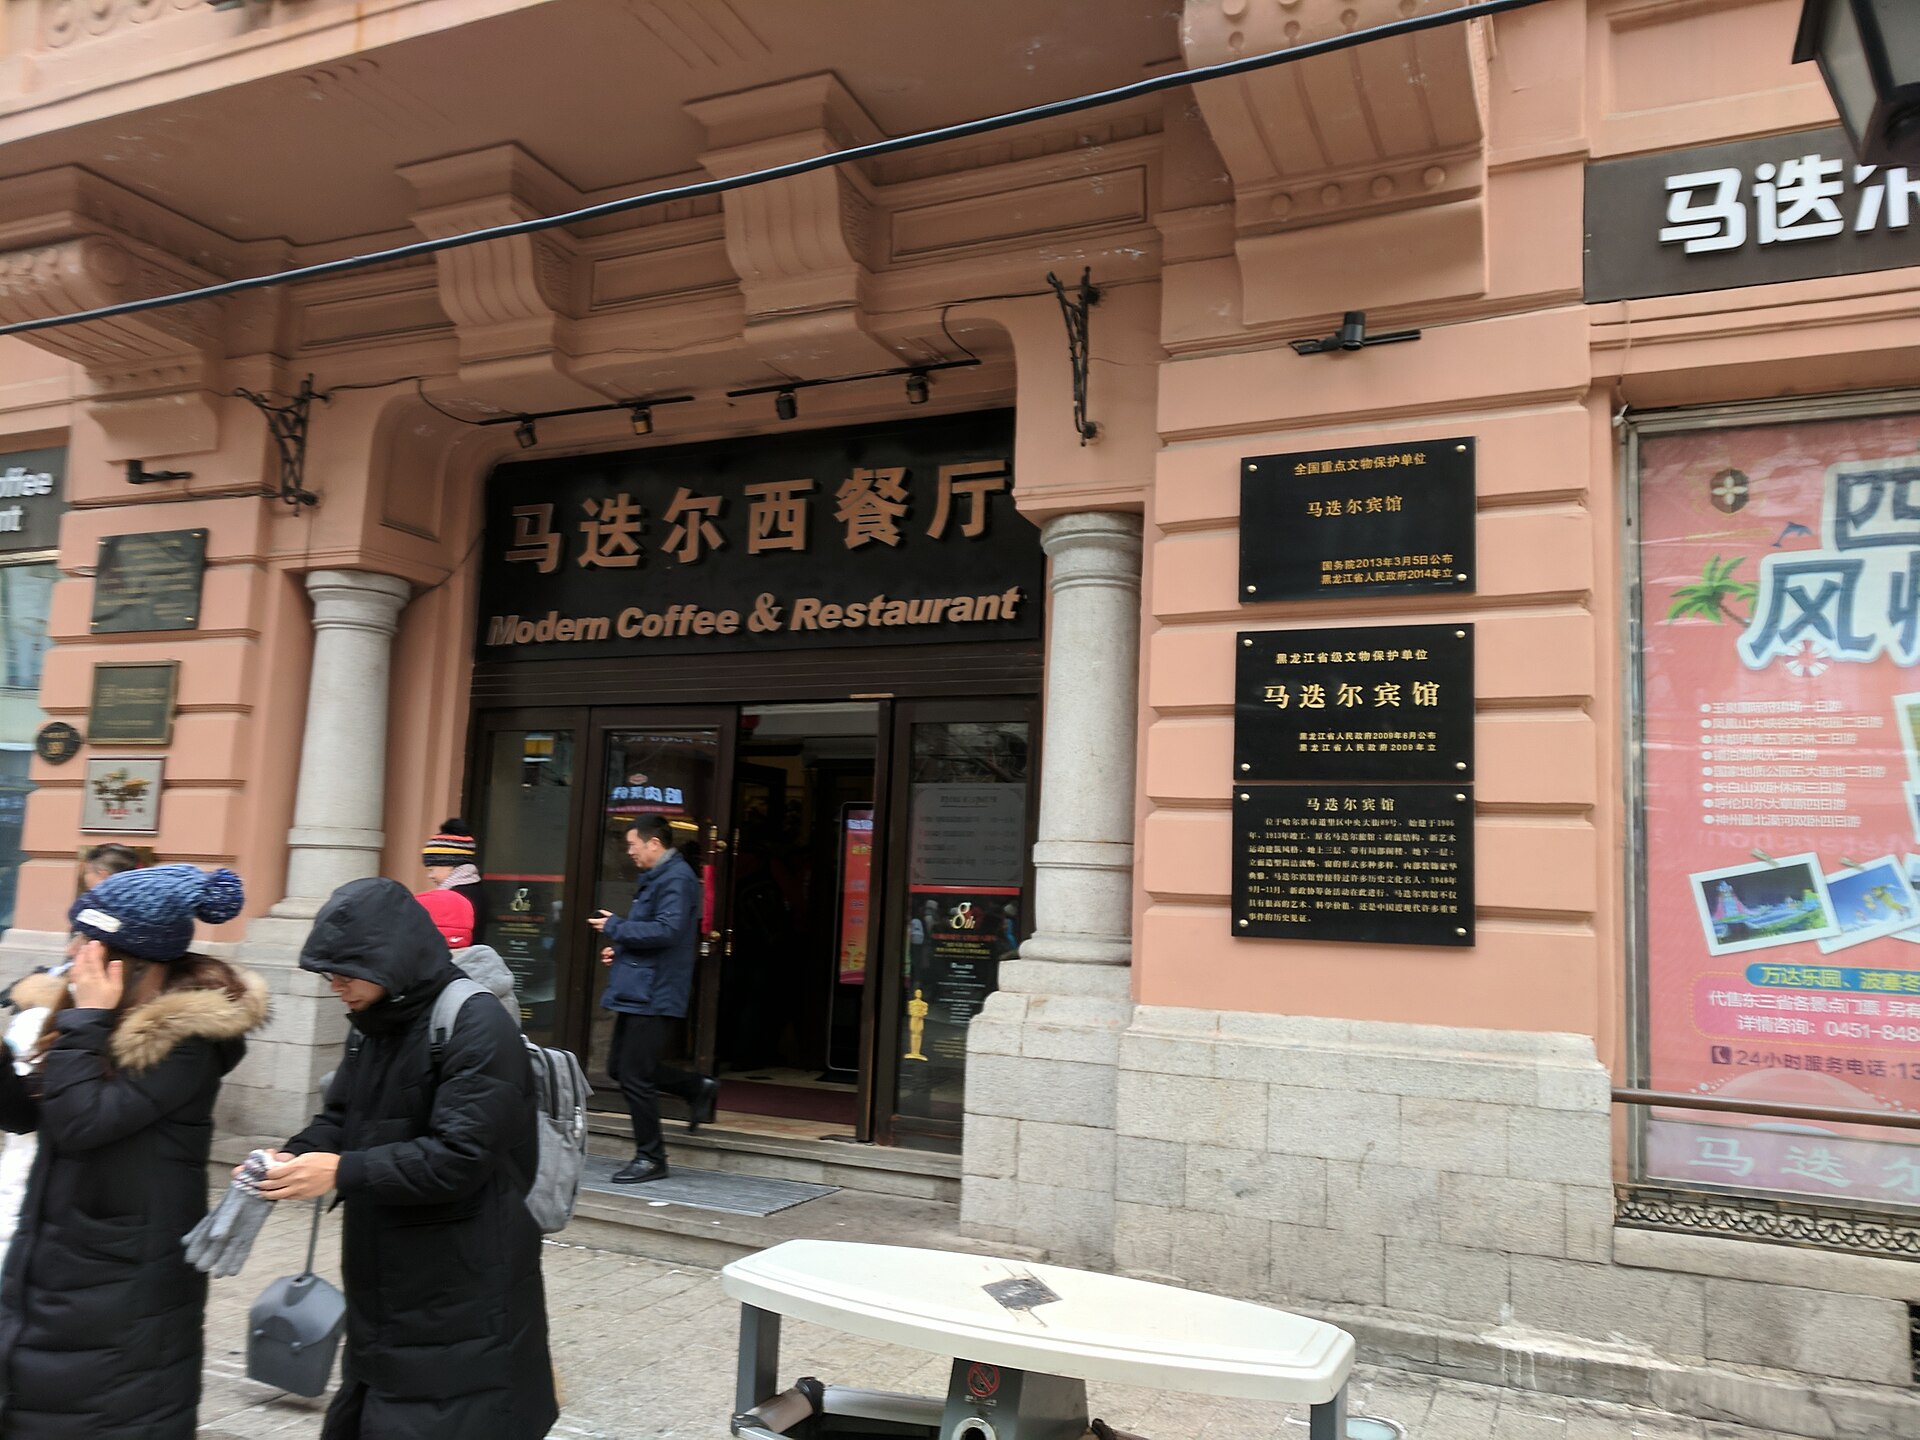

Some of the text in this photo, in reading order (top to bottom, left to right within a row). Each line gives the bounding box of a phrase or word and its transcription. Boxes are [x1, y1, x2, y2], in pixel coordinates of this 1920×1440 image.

[1294, 453, 1427, 476] 全国重点文物保护单位
[1306, 495, 1403, 517] 马迭尔宾馆
[505, 460, 1006, 574] 马迭尔西餐厅
[1321, 554, 1453, 571] 国务院2013年3月5日公布
[1320, 568, 1453, 585] 黑龙江省人民政府2014年立
[487, 586, 1020, 646] Modern Coffee & Restaurant
[1276, 649, 1428, 664] 黑龙江省级文物保护单位
[1264, 681, 1440, 709] 马迭尔宾馆
[1299, 743, 1437, 752] 黑龙江省人民政府2009年立
[1306, 797, 1395, 812] 马迭尔宾馆
